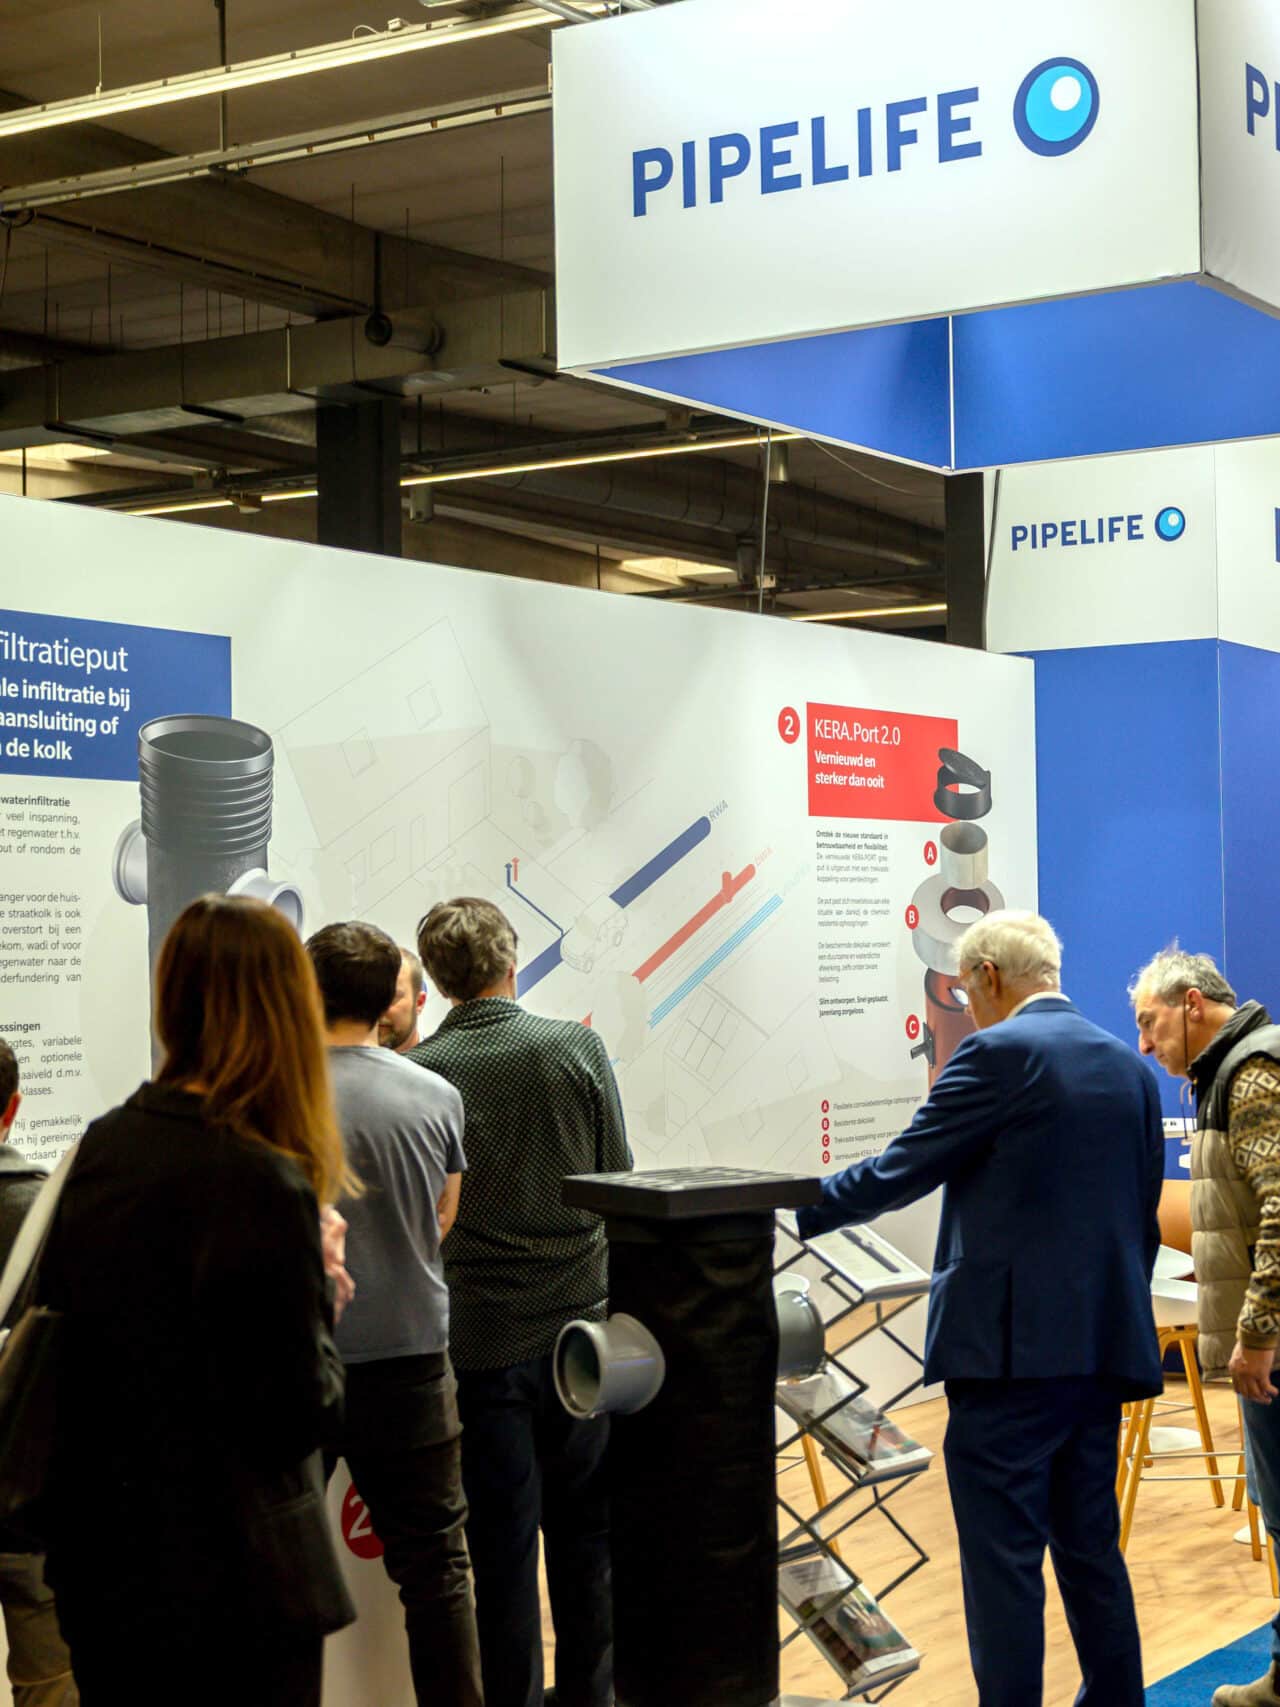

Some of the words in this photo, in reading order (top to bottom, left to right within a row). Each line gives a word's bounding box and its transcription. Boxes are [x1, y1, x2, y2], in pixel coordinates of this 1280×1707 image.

[632, 86, 983, 218] PIPELIFE
[1011, 514, 1144, 551] PIPELIFE
[0, 677, 19, 697] le
[22, 678, 105, 705] infiltratie
[108, 687, 131, 712] bij
[100, 716, 119, 735] of
[784, 715, 794, 735] 2
[815, 718, 880, 744] KERA.Port
[881, 725, 901, 746] 2.0
[6, 737, 30, 757] de
[33, 738, 73, 760] kolk
[814, 749, 863, 767] Vernieuwd
[864, 756, 876, 768] en
[815, 771, 848, 786] sterker
[849, 772, 866, 787] dan
[867, 775, 884, 789] ooit
[8, 828, 58, 840] regenwater
[927, 846, 935, 860] A
[908, 910, 915, 924] B
[909, 1020, 917, 1034] C
[21, 1068, 52, 1080] aaiveld
[24, 1149, 57, 1160] ndaard
[349, 1494, 373, 1540] 2
